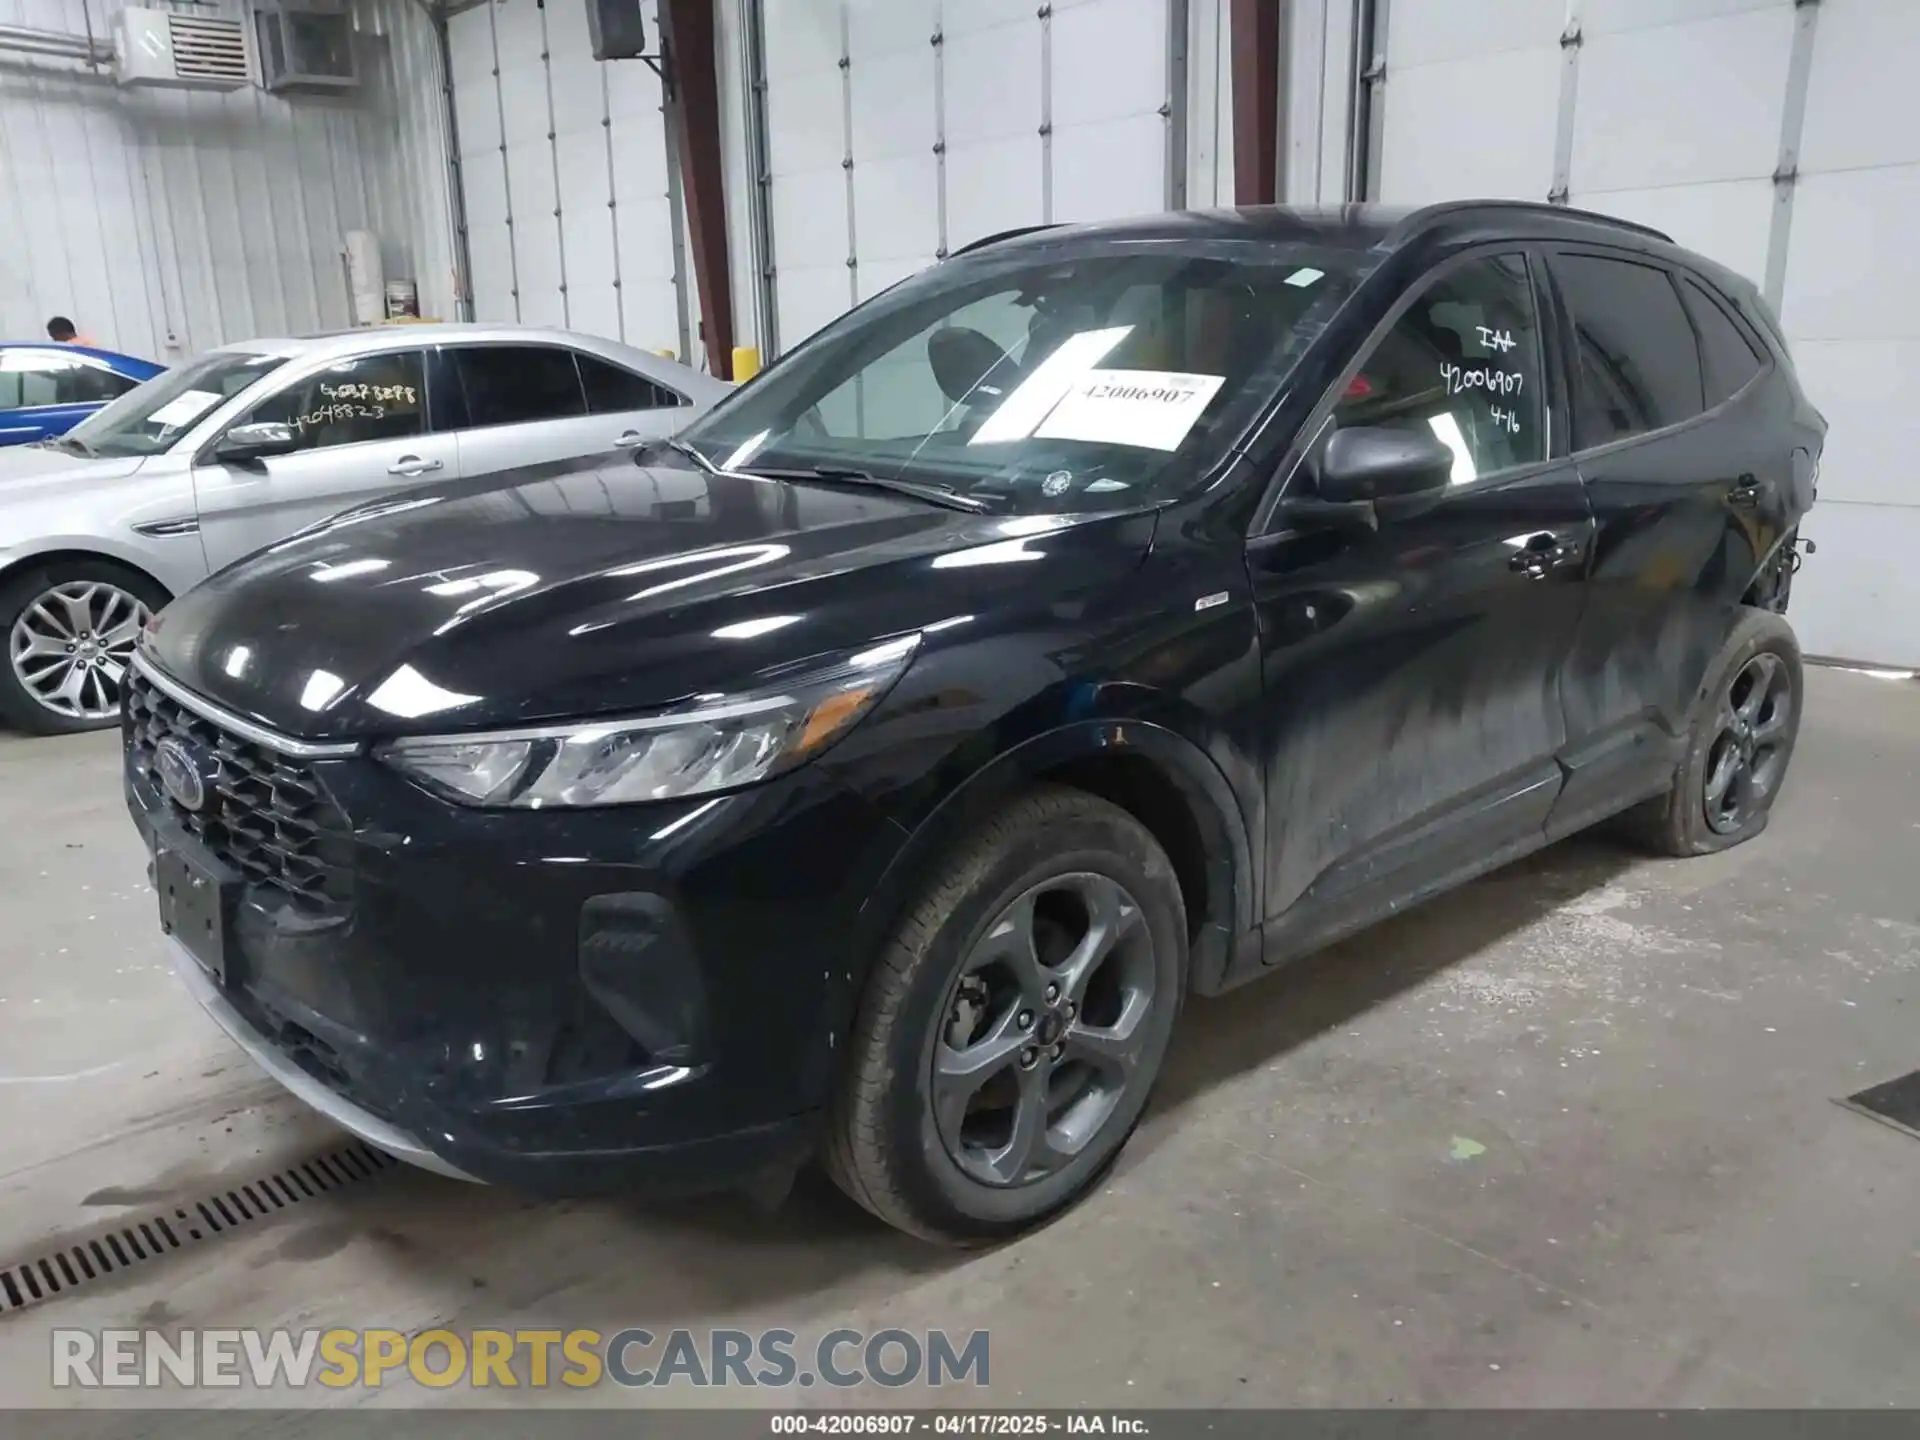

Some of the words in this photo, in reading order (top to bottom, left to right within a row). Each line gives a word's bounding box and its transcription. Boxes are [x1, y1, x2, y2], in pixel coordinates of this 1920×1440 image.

[1440, 362, 1523, 396] 42006907
[1083, 385, 1195, 404] 42006907
[1490, 404, 1520, 432] 4-16
